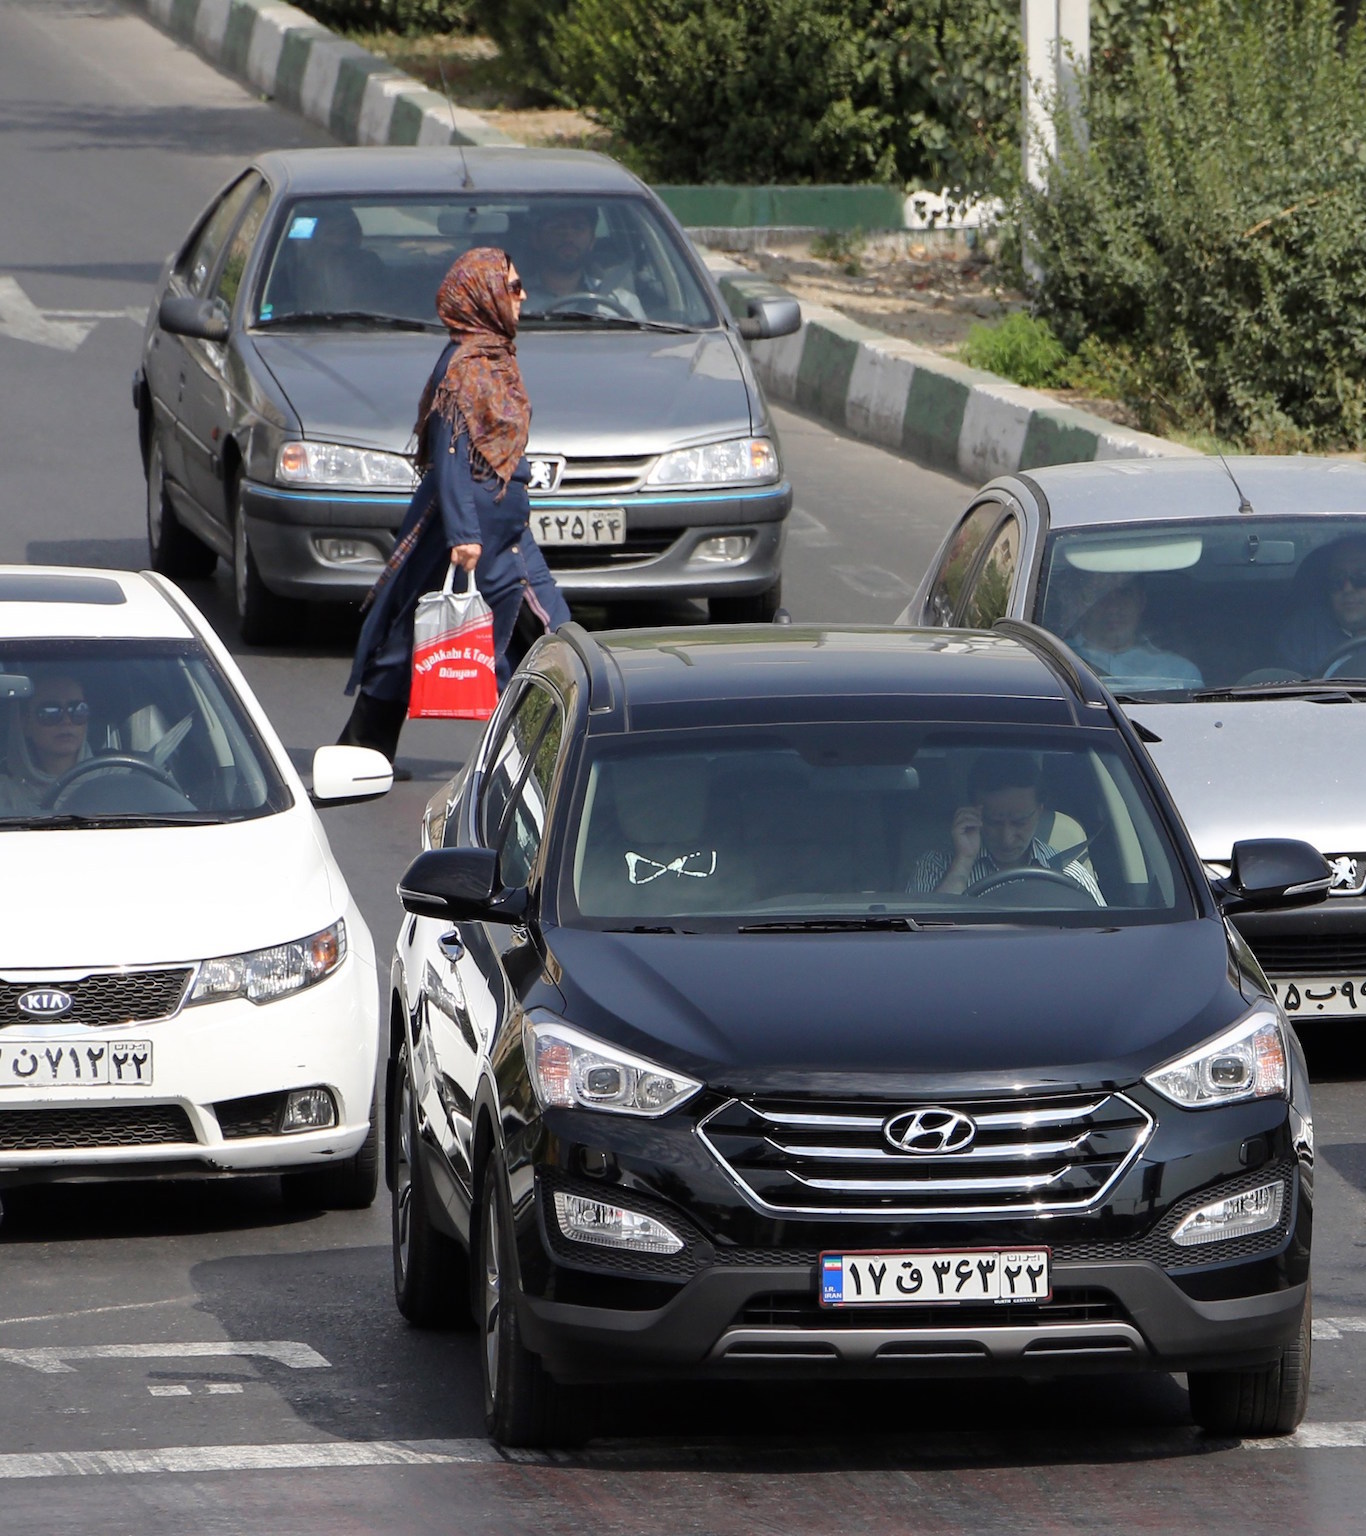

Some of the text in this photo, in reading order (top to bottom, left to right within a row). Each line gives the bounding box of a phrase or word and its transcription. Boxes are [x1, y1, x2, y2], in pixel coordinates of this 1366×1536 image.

[415, 647, 495, 675] Ayakkabı & Terli
[439, 667, 478, 681] Dünyası
[27, 994, 63, 1009] KIA
[114, 1043, 146, 1051] ایران
[1006, 1254, 1041, 1262] ایران
